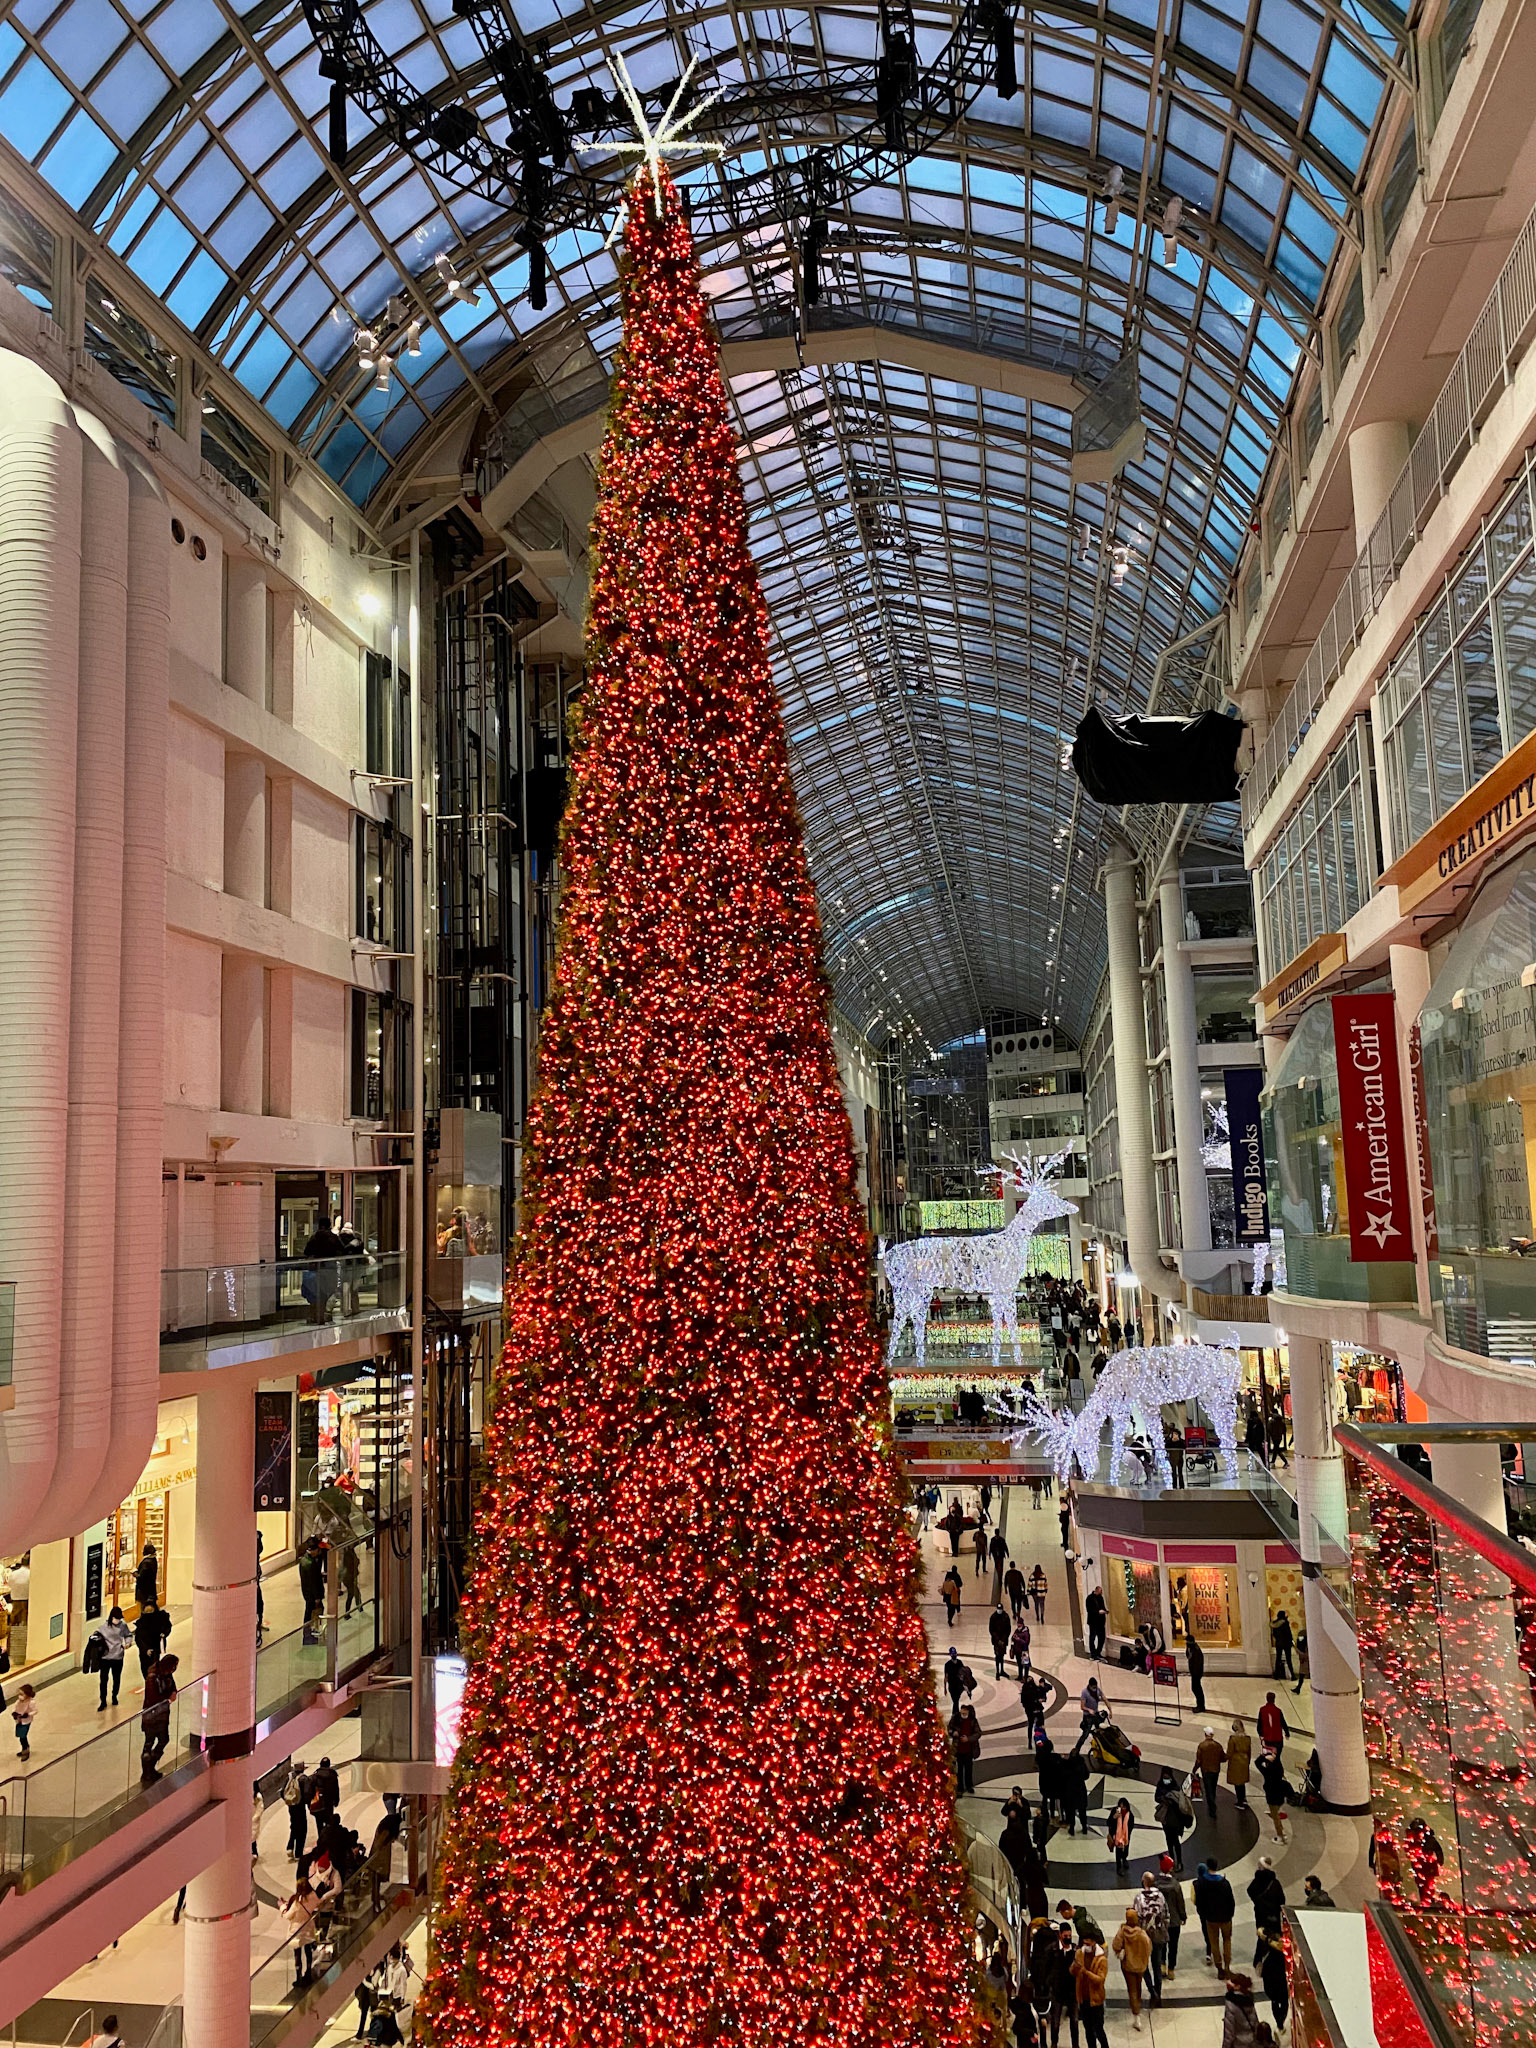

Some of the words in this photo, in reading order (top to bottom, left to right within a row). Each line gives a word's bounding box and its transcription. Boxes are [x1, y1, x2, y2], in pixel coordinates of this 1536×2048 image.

[1438, 773, 1535, 878] CREATIVITY
[1278, 961, 1319, 1009] IMAGINATION
[1502, 1005, 1521, 1031] from
[1349, 1022, 1382, 1072] Girl
[1240, 1124, 1261, 1178] Books
[1355, 1074, 1392, 1207] American
[1194, 1583, 1219, 1591] LOVE
[1197, 1622, 1220, 1630] PINK
